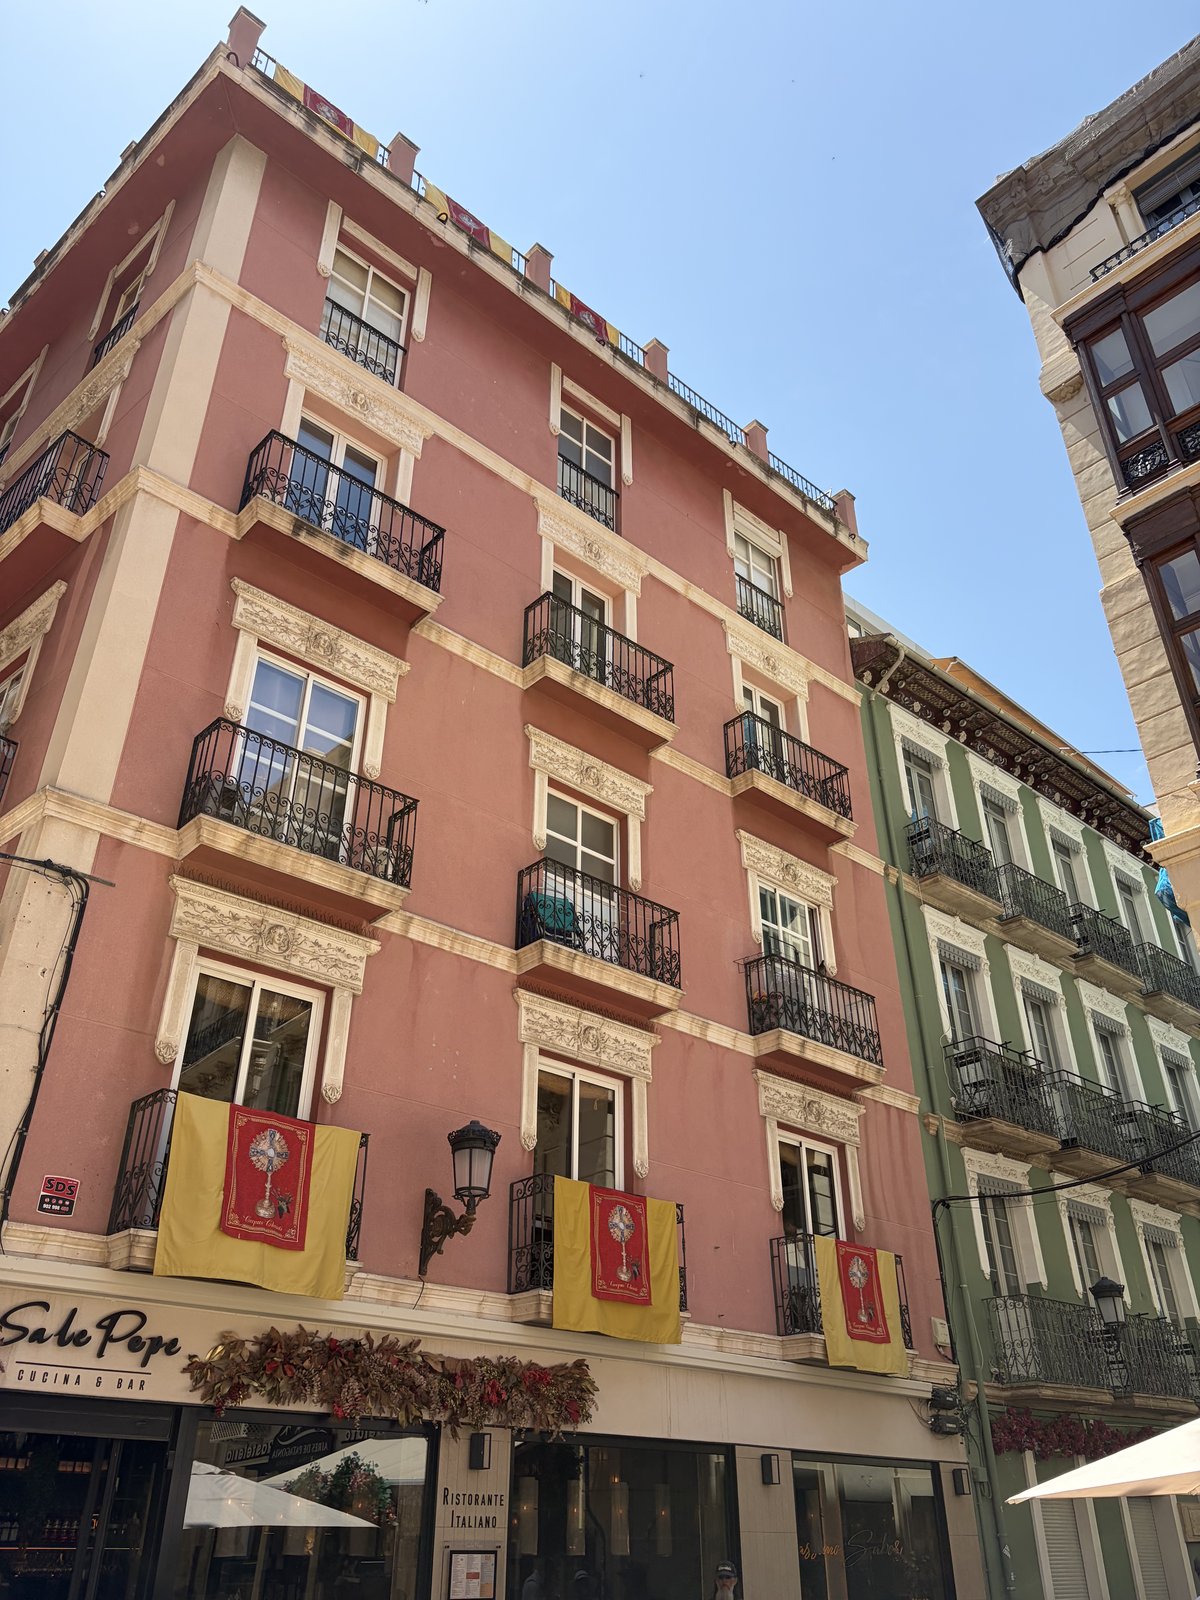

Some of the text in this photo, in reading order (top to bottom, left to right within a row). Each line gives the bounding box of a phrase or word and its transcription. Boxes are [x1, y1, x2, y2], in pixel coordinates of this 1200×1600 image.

[45, 1178, 76, 1196] SDS
[0, 1301, 181, 1368] Sale Pepe
[17, 1369, 146, 1391] CUCINA & BAR
